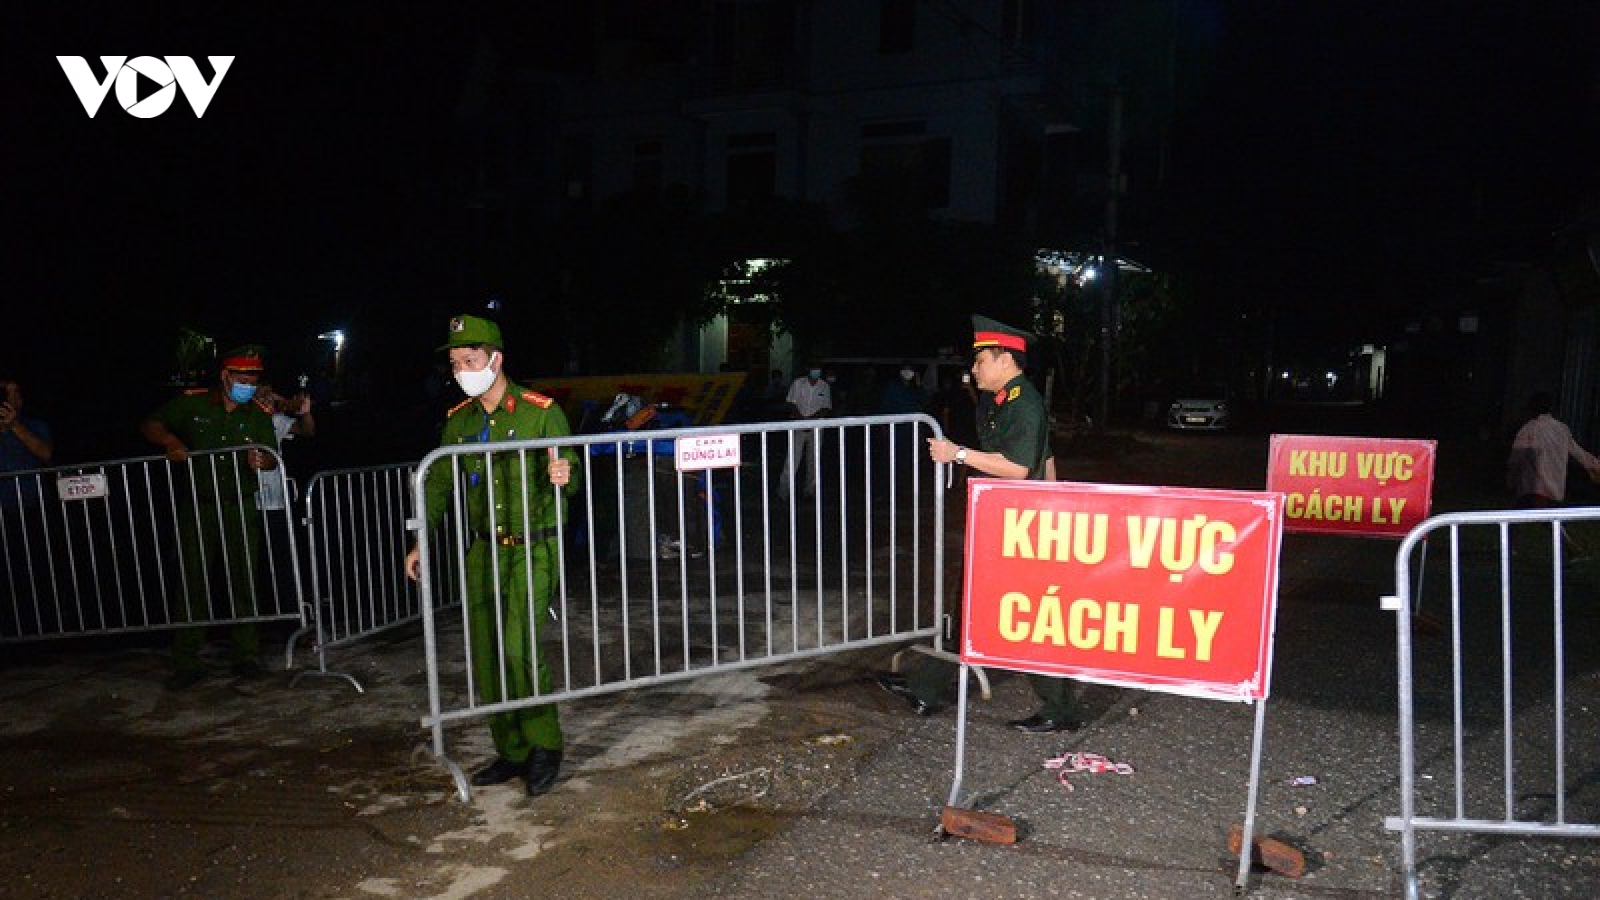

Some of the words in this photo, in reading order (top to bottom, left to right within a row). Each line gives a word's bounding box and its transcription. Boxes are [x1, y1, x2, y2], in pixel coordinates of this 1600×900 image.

[1289, 450, 1349, 478] KHU
[1357, 452, 1414, 486] VỰC
[1286, 489, 1364, 522] CÁCH
[1371, 497, 1408, 525] LY
[1002, 508, 1109, 565] KHU
[1127, 514, 1236, 582] VỰC
[998, 585, 1140, 654] CÁCH
[1156, 607, 1224, 661] LY
